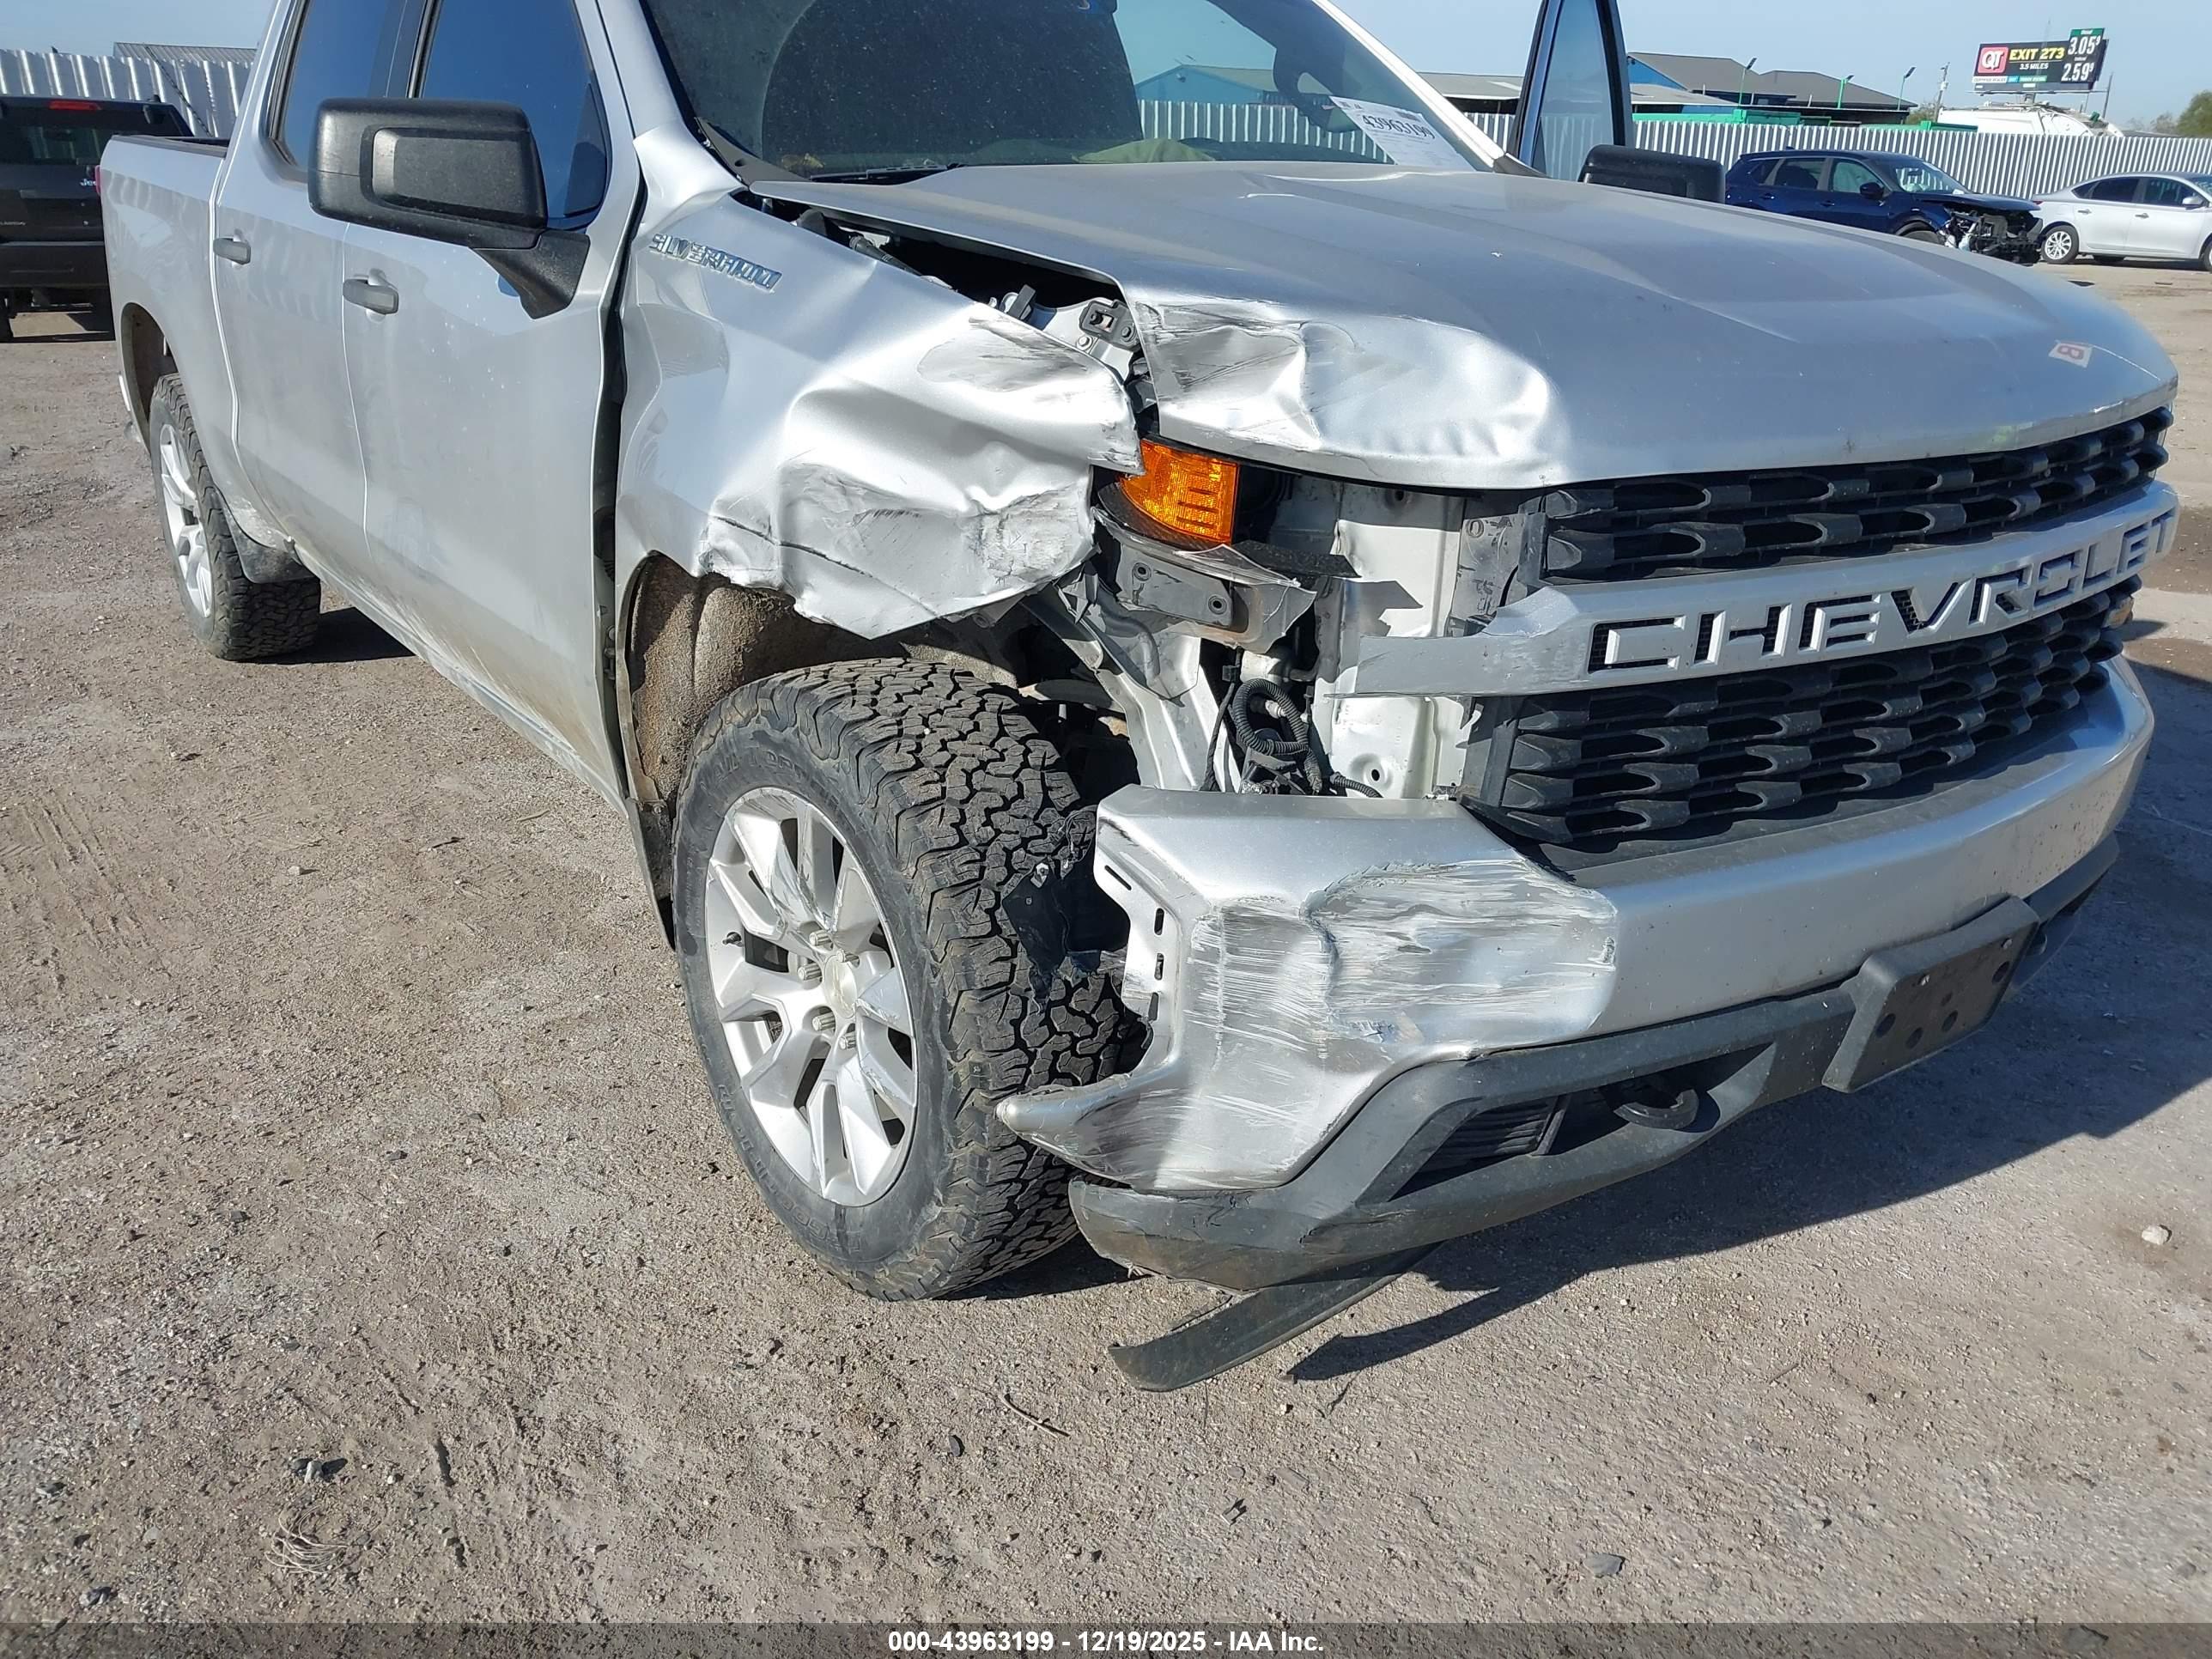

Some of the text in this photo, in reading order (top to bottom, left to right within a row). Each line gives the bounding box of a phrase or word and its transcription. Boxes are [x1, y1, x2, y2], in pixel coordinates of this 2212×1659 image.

[1981, 51, 2003, 70] QT
[2008, 48, 2039, 61] EXIT
[2039, 46, 2065, 60] 273
[1362, 115, 1436, 139] 43963199
[1588, 513, 2174, 673] CHEVROLET
